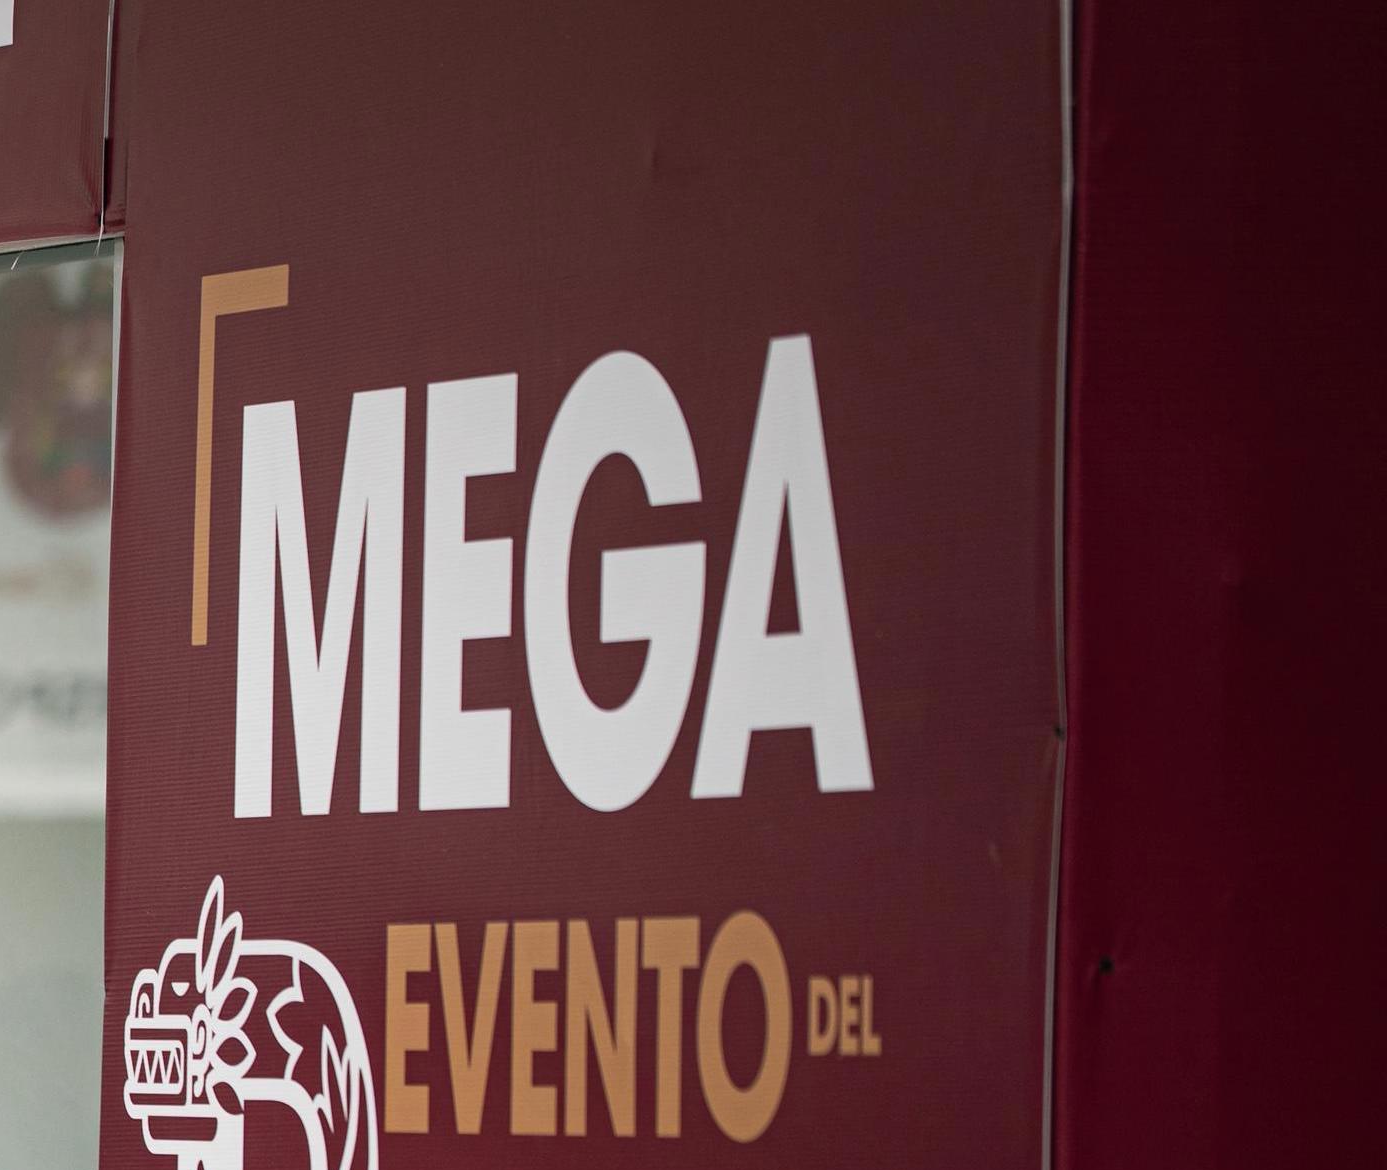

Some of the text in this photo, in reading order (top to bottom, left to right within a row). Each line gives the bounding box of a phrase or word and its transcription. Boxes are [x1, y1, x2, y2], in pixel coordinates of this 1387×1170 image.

[234, 333, 874, 818] MEGA
[384, 909, 881, 1143] EVENTO DEL
